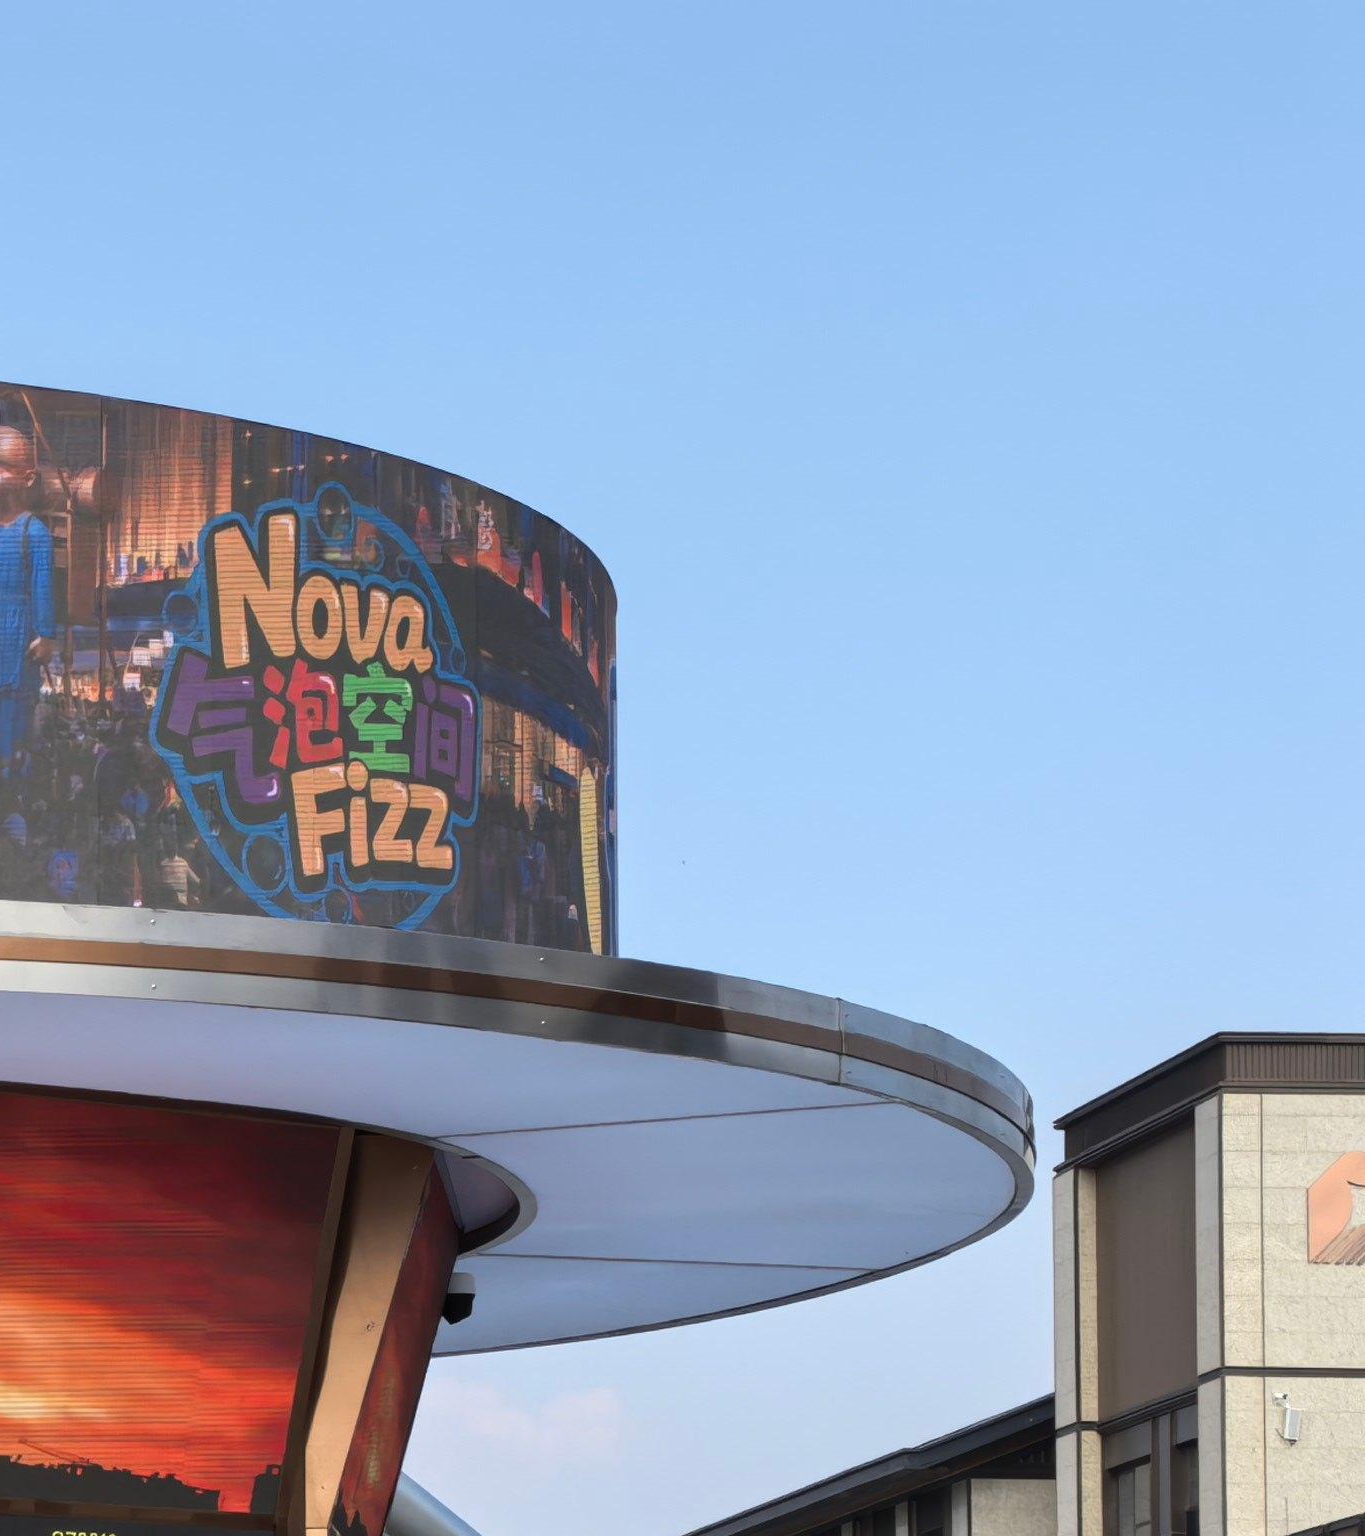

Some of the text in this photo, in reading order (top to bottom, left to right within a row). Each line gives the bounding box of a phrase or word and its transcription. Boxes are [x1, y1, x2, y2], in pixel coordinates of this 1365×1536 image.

[212, 512, 433, 672] Nova
[168, 660, 473, 800] 气泡空间
[291, 761, 453, 877] Fizz
